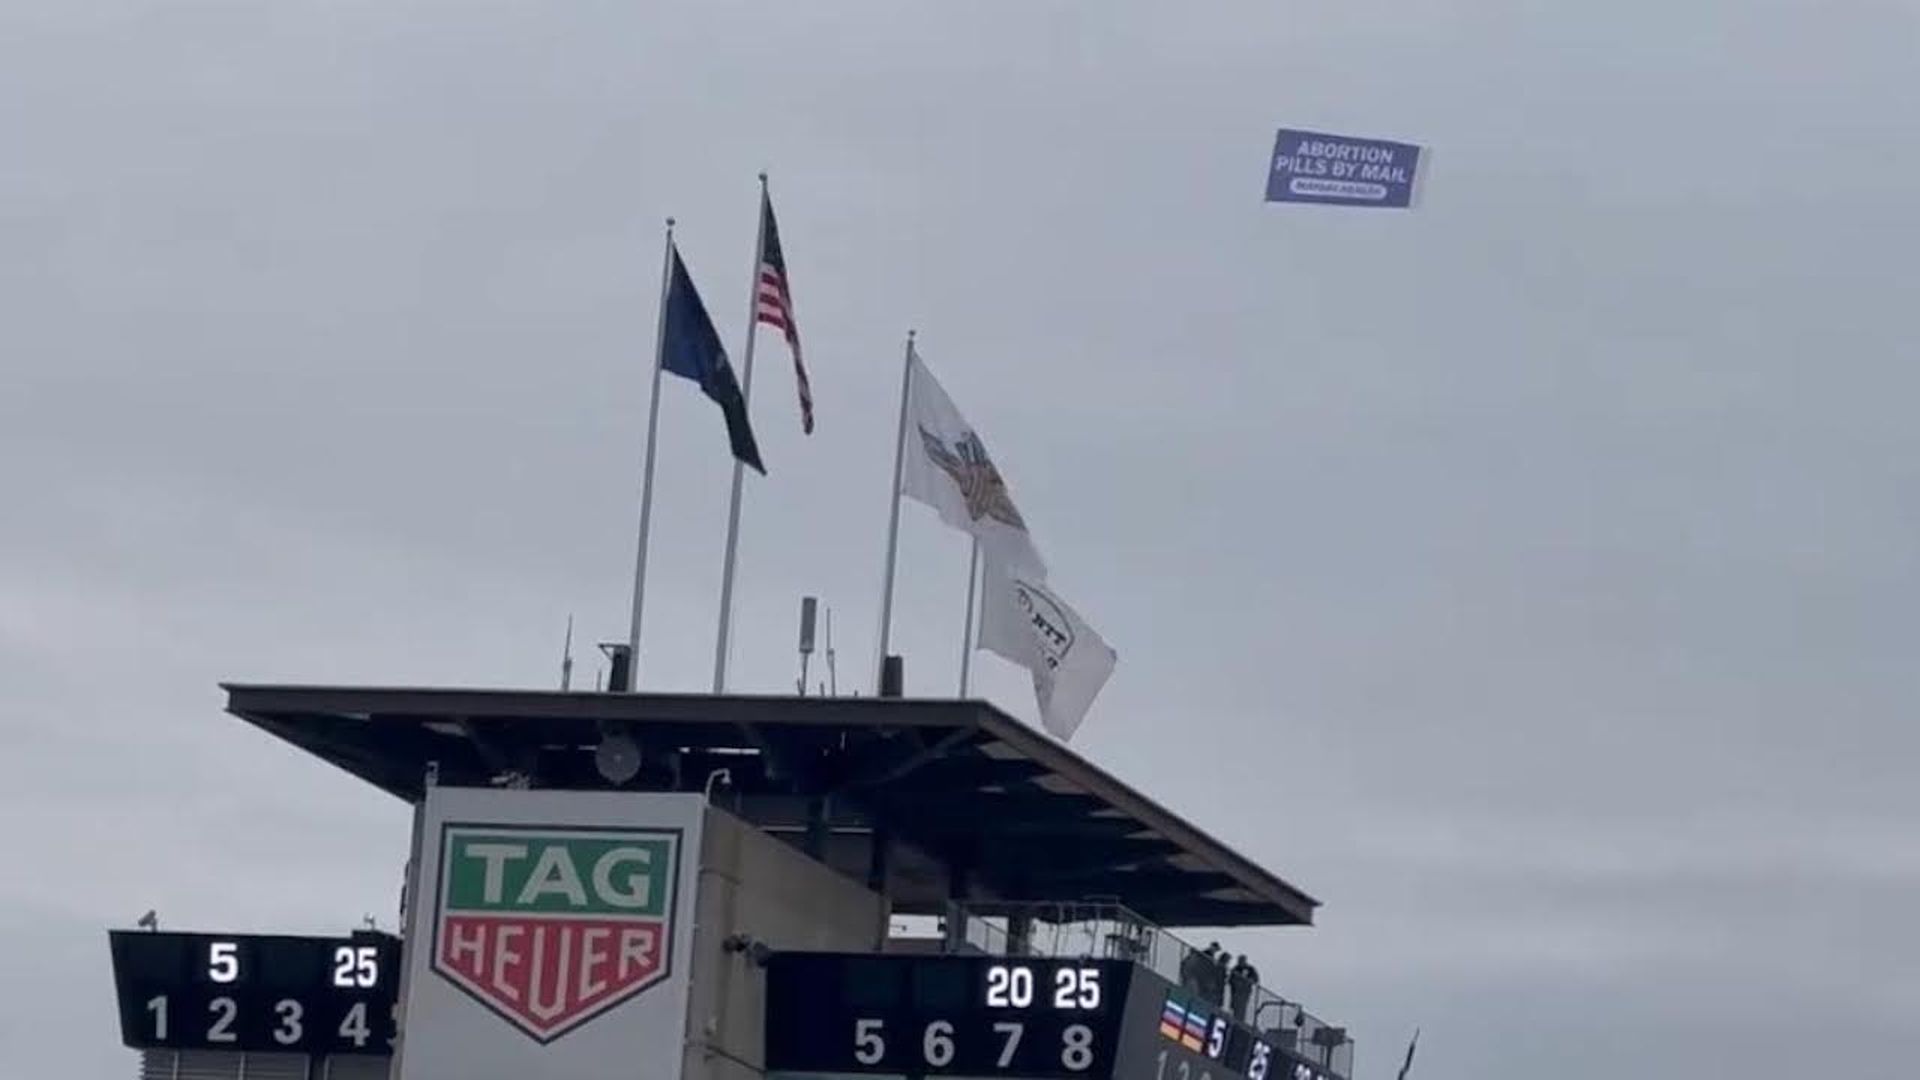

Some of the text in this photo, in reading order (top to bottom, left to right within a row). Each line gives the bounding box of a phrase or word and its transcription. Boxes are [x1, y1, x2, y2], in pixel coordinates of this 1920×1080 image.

[1275, 155, 1408, 184] PILLS BY MAIL
[1296, 140, 1395, 163] ABORTION
[464, 843, 652, 908] TAG
[208, 942, 379, 988] 5 25
[450, 923, 656, 1022] HEUER
[986, 966, 1101, 1010] 20 25
[146, 995, 169, 1040] 1
[206, 997, 238, 1042] 2
[272, 998, 304, 1046] 3
[338, 1001, 372, 1047] 4
[1208, 1017, 1226, 1059] 5
[854, 1018, 1095, 1071] 5 6 7 8
